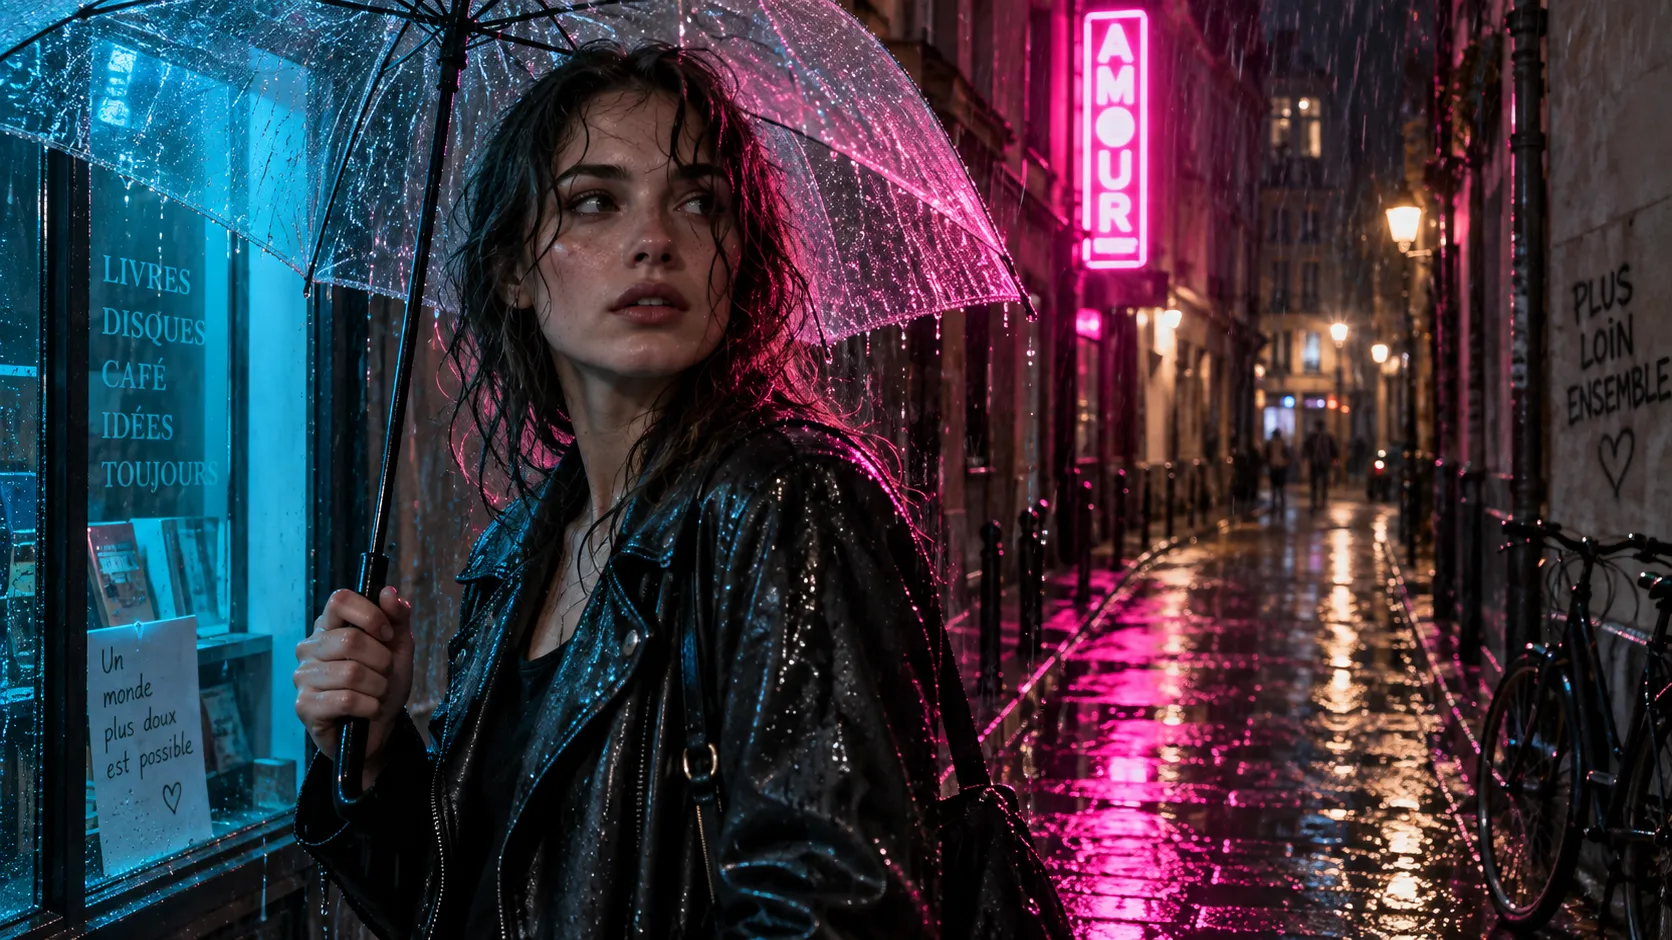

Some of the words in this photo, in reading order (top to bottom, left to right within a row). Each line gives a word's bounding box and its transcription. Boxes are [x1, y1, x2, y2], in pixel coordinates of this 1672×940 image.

[1095, 22, 1136, 234] AMOUR
[103, 254, 191, 296] LIVRES
[1572, 263, 1633, 326] PLUS
[102, 306, 206, 346] DISQUES
[102, 357, 167, 391] CAFÉ
[1567, 357, 1671, 426] ENSEMBLE
[102, 405, 173, 441] IDÉES
[101, 460, 219, 493] TOUJOURS
[101, 646, 124, 674] Un
[103, 673, 153, 708] monde
[104, 715, 135, 754] plus
[143, 706, 177, 732] doux
[107, 750, 130, 779] est
[139, 730, 194, 780] possible
